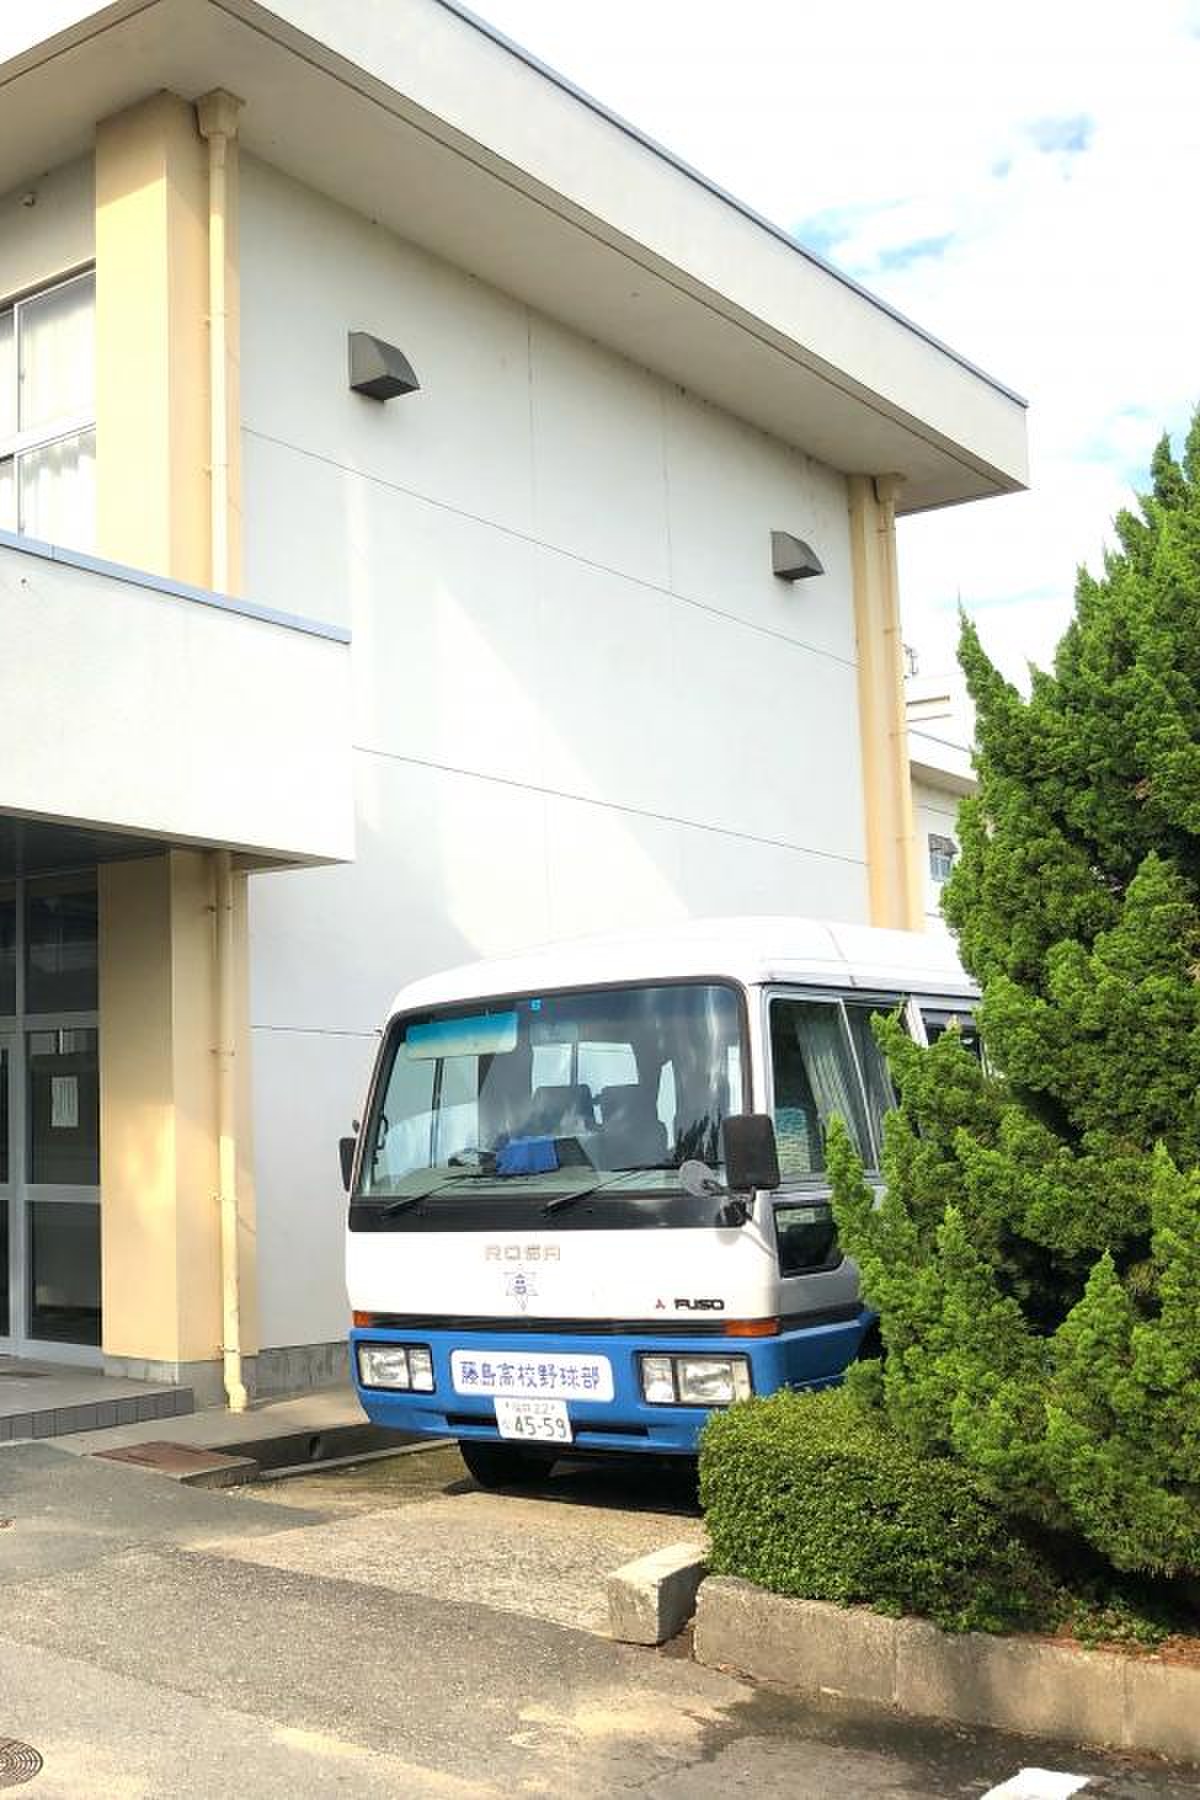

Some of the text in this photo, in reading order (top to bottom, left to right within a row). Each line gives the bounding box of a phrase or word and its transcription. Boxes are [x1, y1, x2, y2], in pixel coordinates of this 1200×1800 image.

[485, 1245, 561, 1261] ROSA
[674, 1298, 725, 1311] FUSO
[459, 1360, 600, 1391] 藤島高校野球部
[514, 1415, 567, 1439] 45-59
